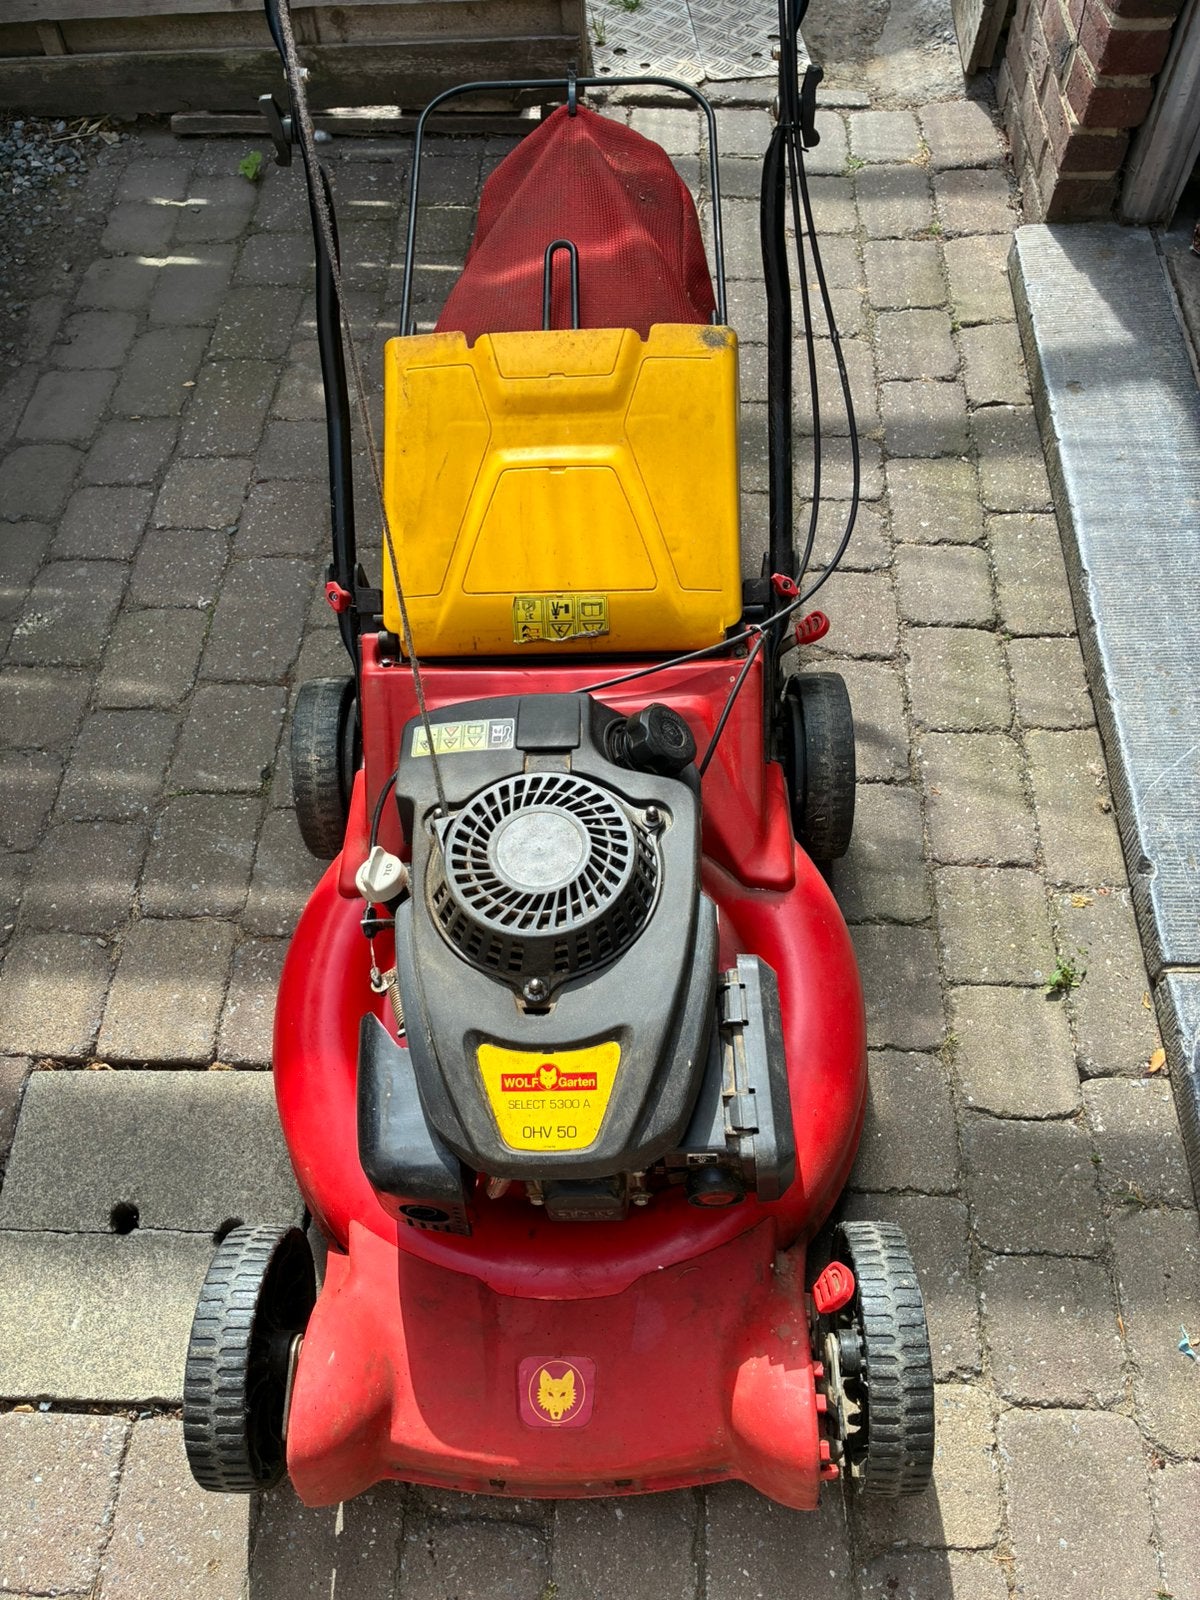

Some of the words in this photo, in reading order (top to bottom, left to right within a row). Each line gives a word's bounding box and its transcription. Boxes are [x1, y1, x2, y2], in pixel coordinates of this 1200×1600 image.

[384, 863, 392, 876] OIL
[503, 1077, 539, 1088] WOLF
[558, 1076, 596, 1088] Garten
[508, 1099, 546, 1110] SELECT
[549, 1099, 580, 1110] 5300
[582, 1098, 591, 1109] A
[522, 1126, 552, 1139] OHV
[557, 1125, 577, 1139] 50
